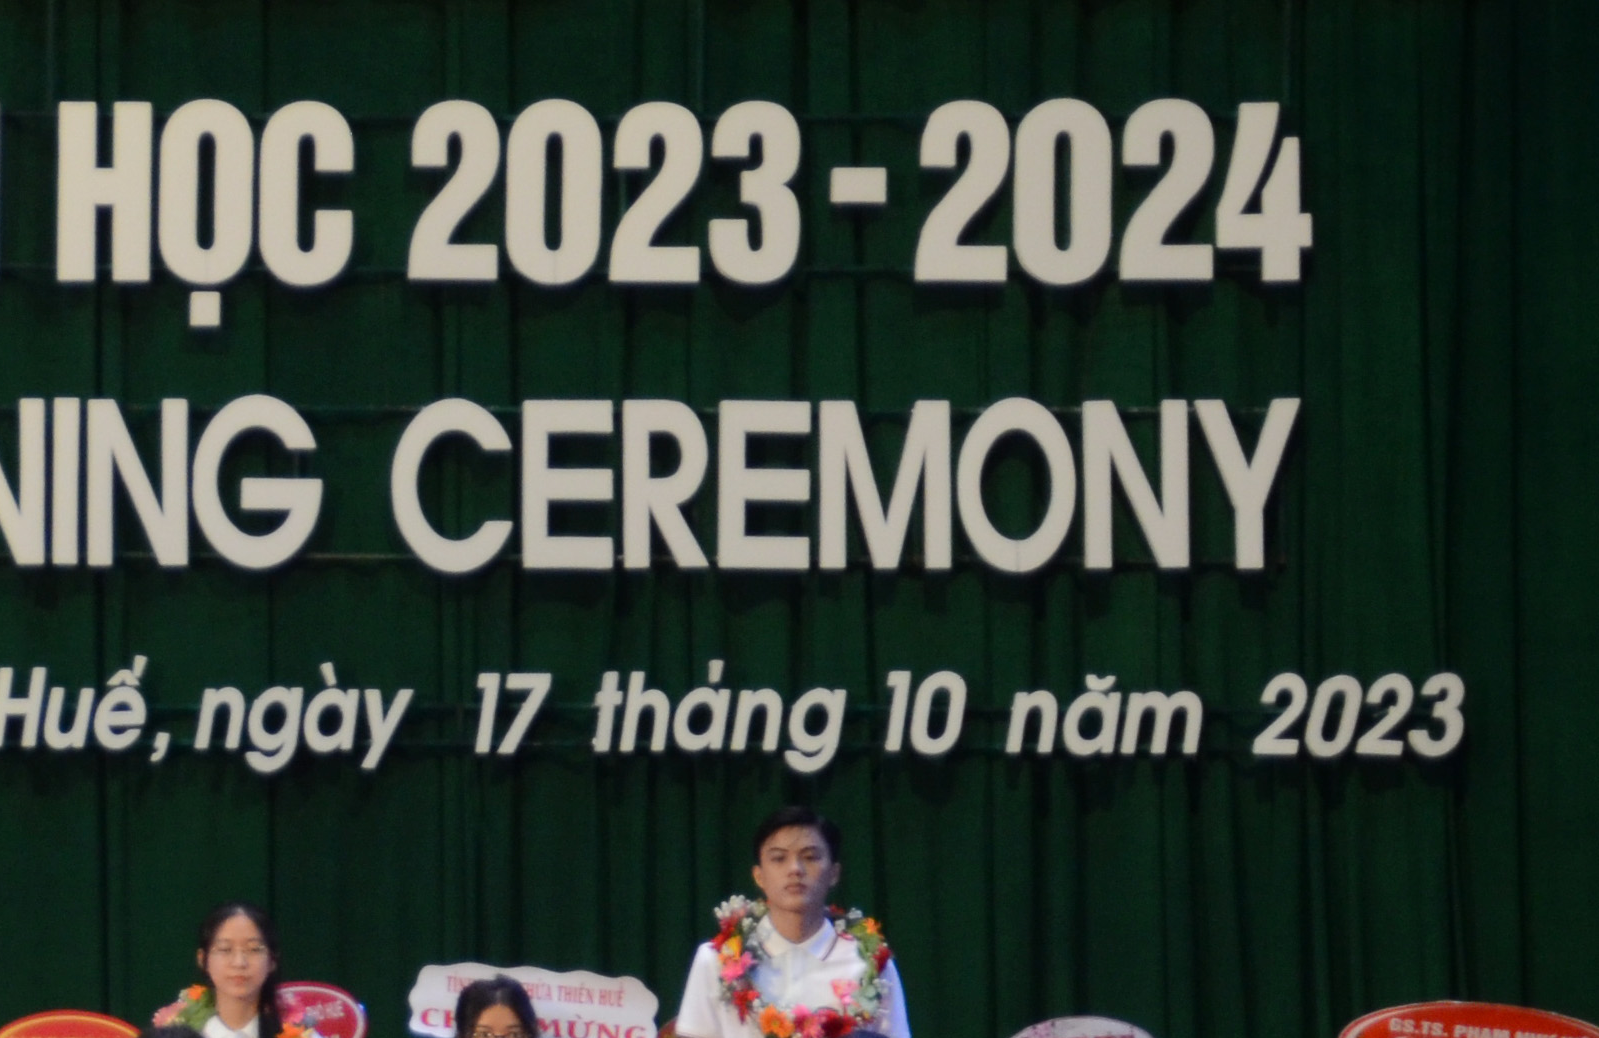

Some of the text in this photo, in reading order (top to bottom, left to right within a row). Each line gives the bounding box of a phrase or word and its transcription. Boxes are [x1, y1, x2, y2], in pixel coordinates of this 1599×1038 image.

[56, 98, 355, 328] HỌC
[407, 98, 801, 286] 2023
[913, 98, 1313, 286] 2024
[390, 396, 1301, 574] CEREMONY
[193, 661, 414, 774] ngày
[474, 672, 552, 755] 17
[591, 659, 847, 774] tháng
[884, 670, 967, 756] 10
[1005, 673, 1203, 757] năm
[1252, 672, 1465, 758] 2023
